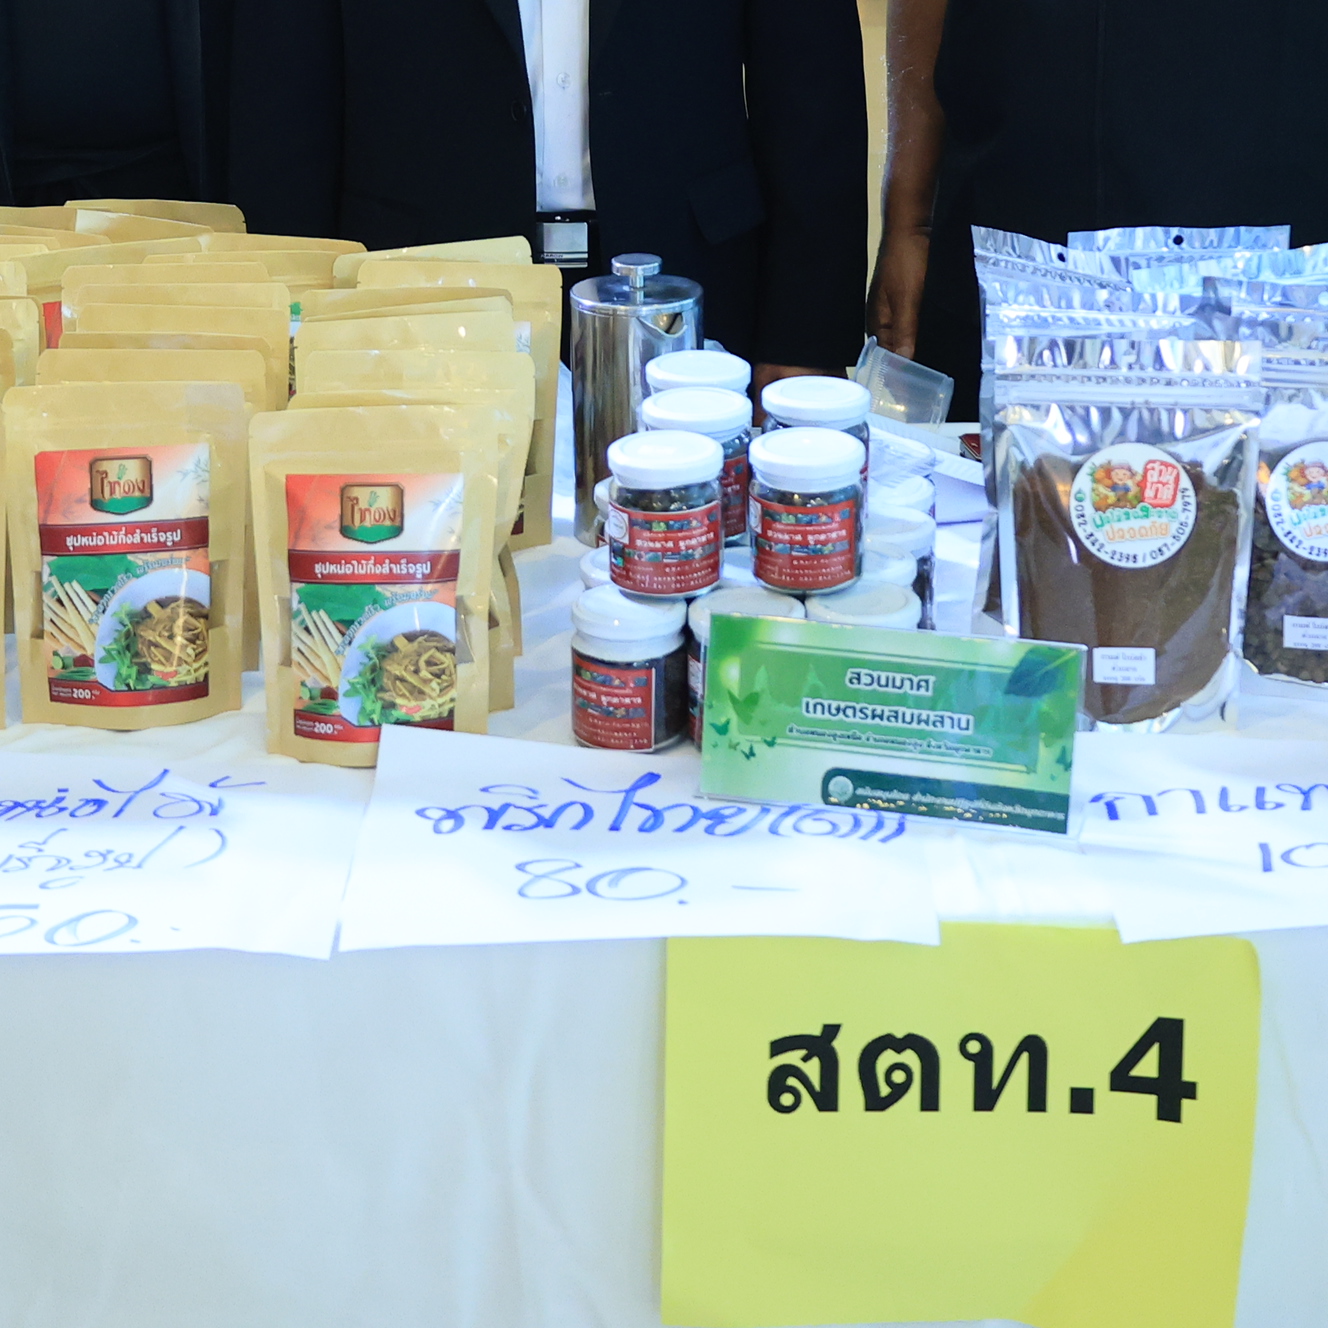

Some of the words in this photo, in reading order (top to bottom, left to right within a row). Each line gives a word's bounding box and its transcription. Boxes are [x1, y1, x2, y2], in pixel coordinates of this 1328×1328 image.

[72, 687, 91, 699] 200
[848, 669, 932, 693] สวนมาศ
[314, 721, 333, 733] 200
[805, 700, 971, 732] เกษตรผสมผสาน
[767, 1016, 1197, 1123] สตท.4
